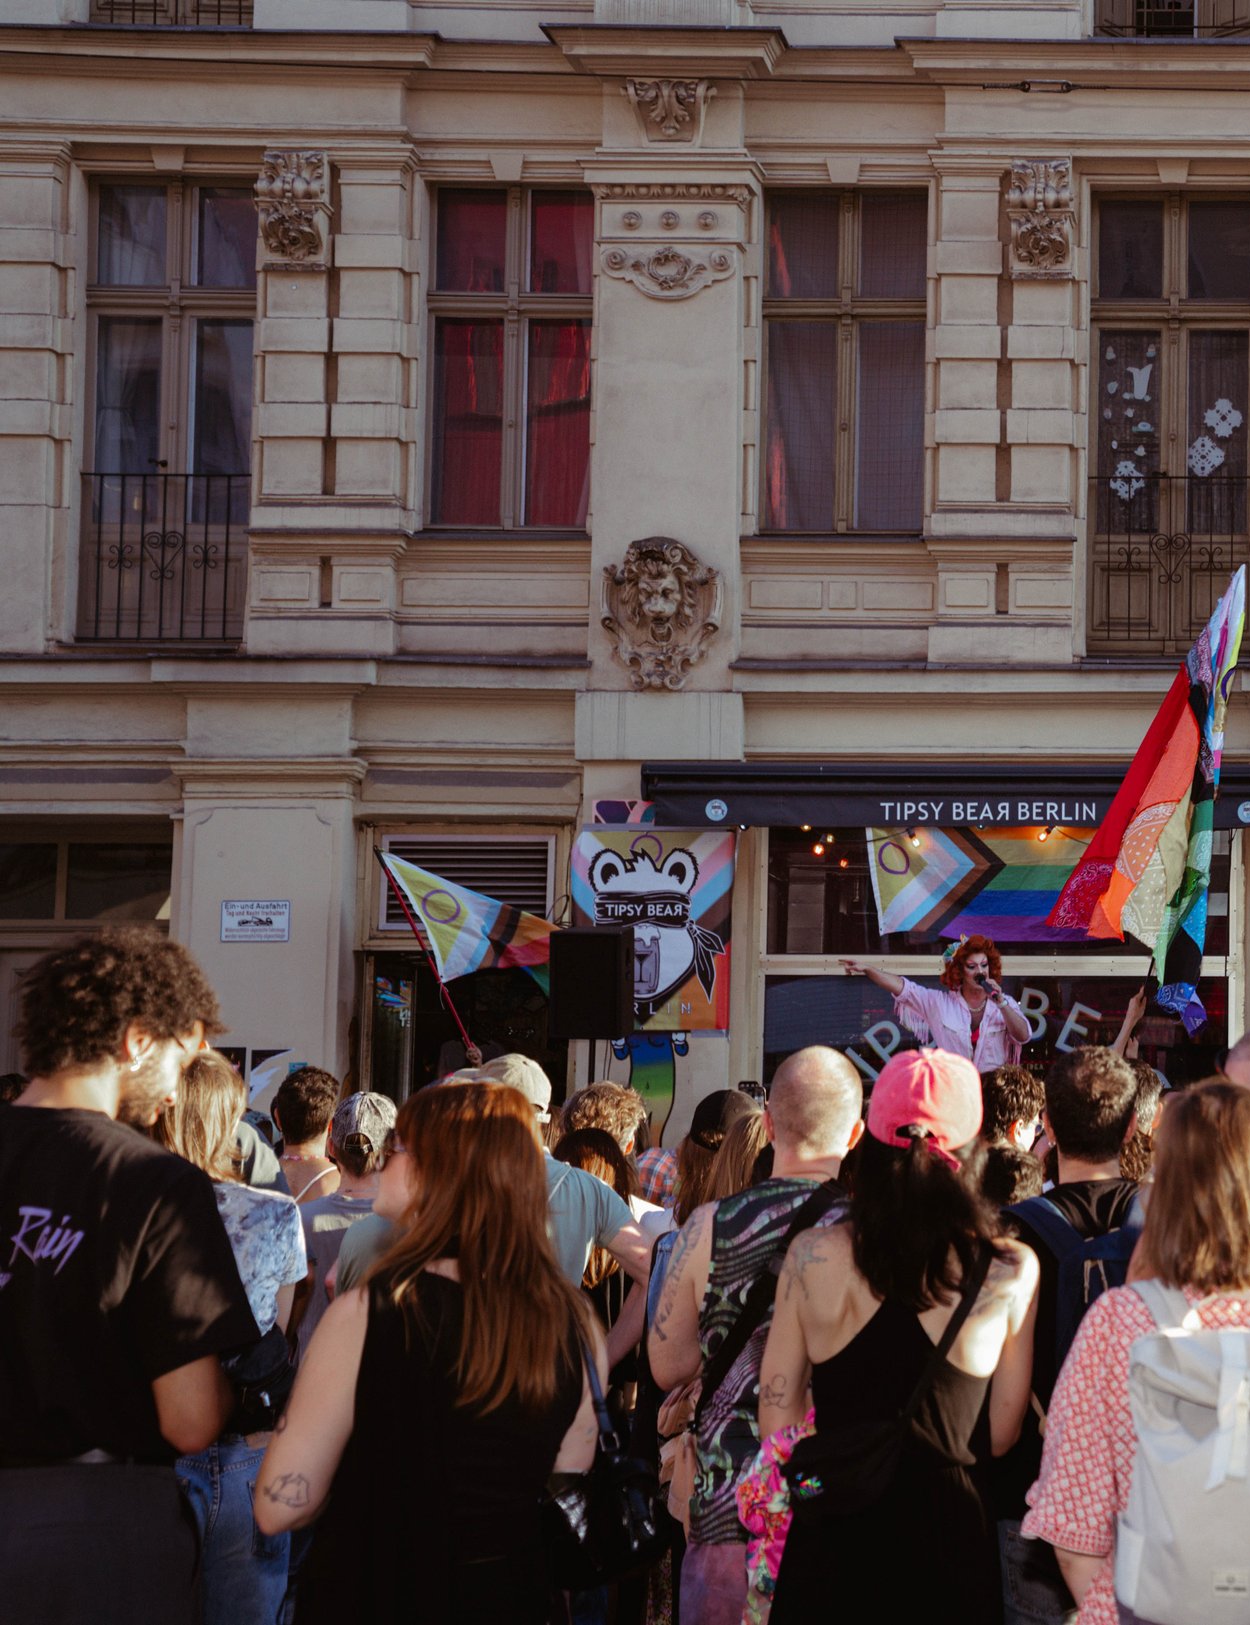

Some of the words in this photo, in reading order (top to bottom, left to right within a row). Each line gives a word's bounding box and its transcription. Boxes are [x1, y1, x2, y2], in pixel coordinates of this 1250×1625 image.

[879, 802, 944, 821] TIPSY
[1017, 802, 1096, 821] BERLIN
[255, 902, 288, 910] Ausfahrt
[605, 903, 644, 917] TIPSY
[633, 1002, 692, 1015] RLIN
